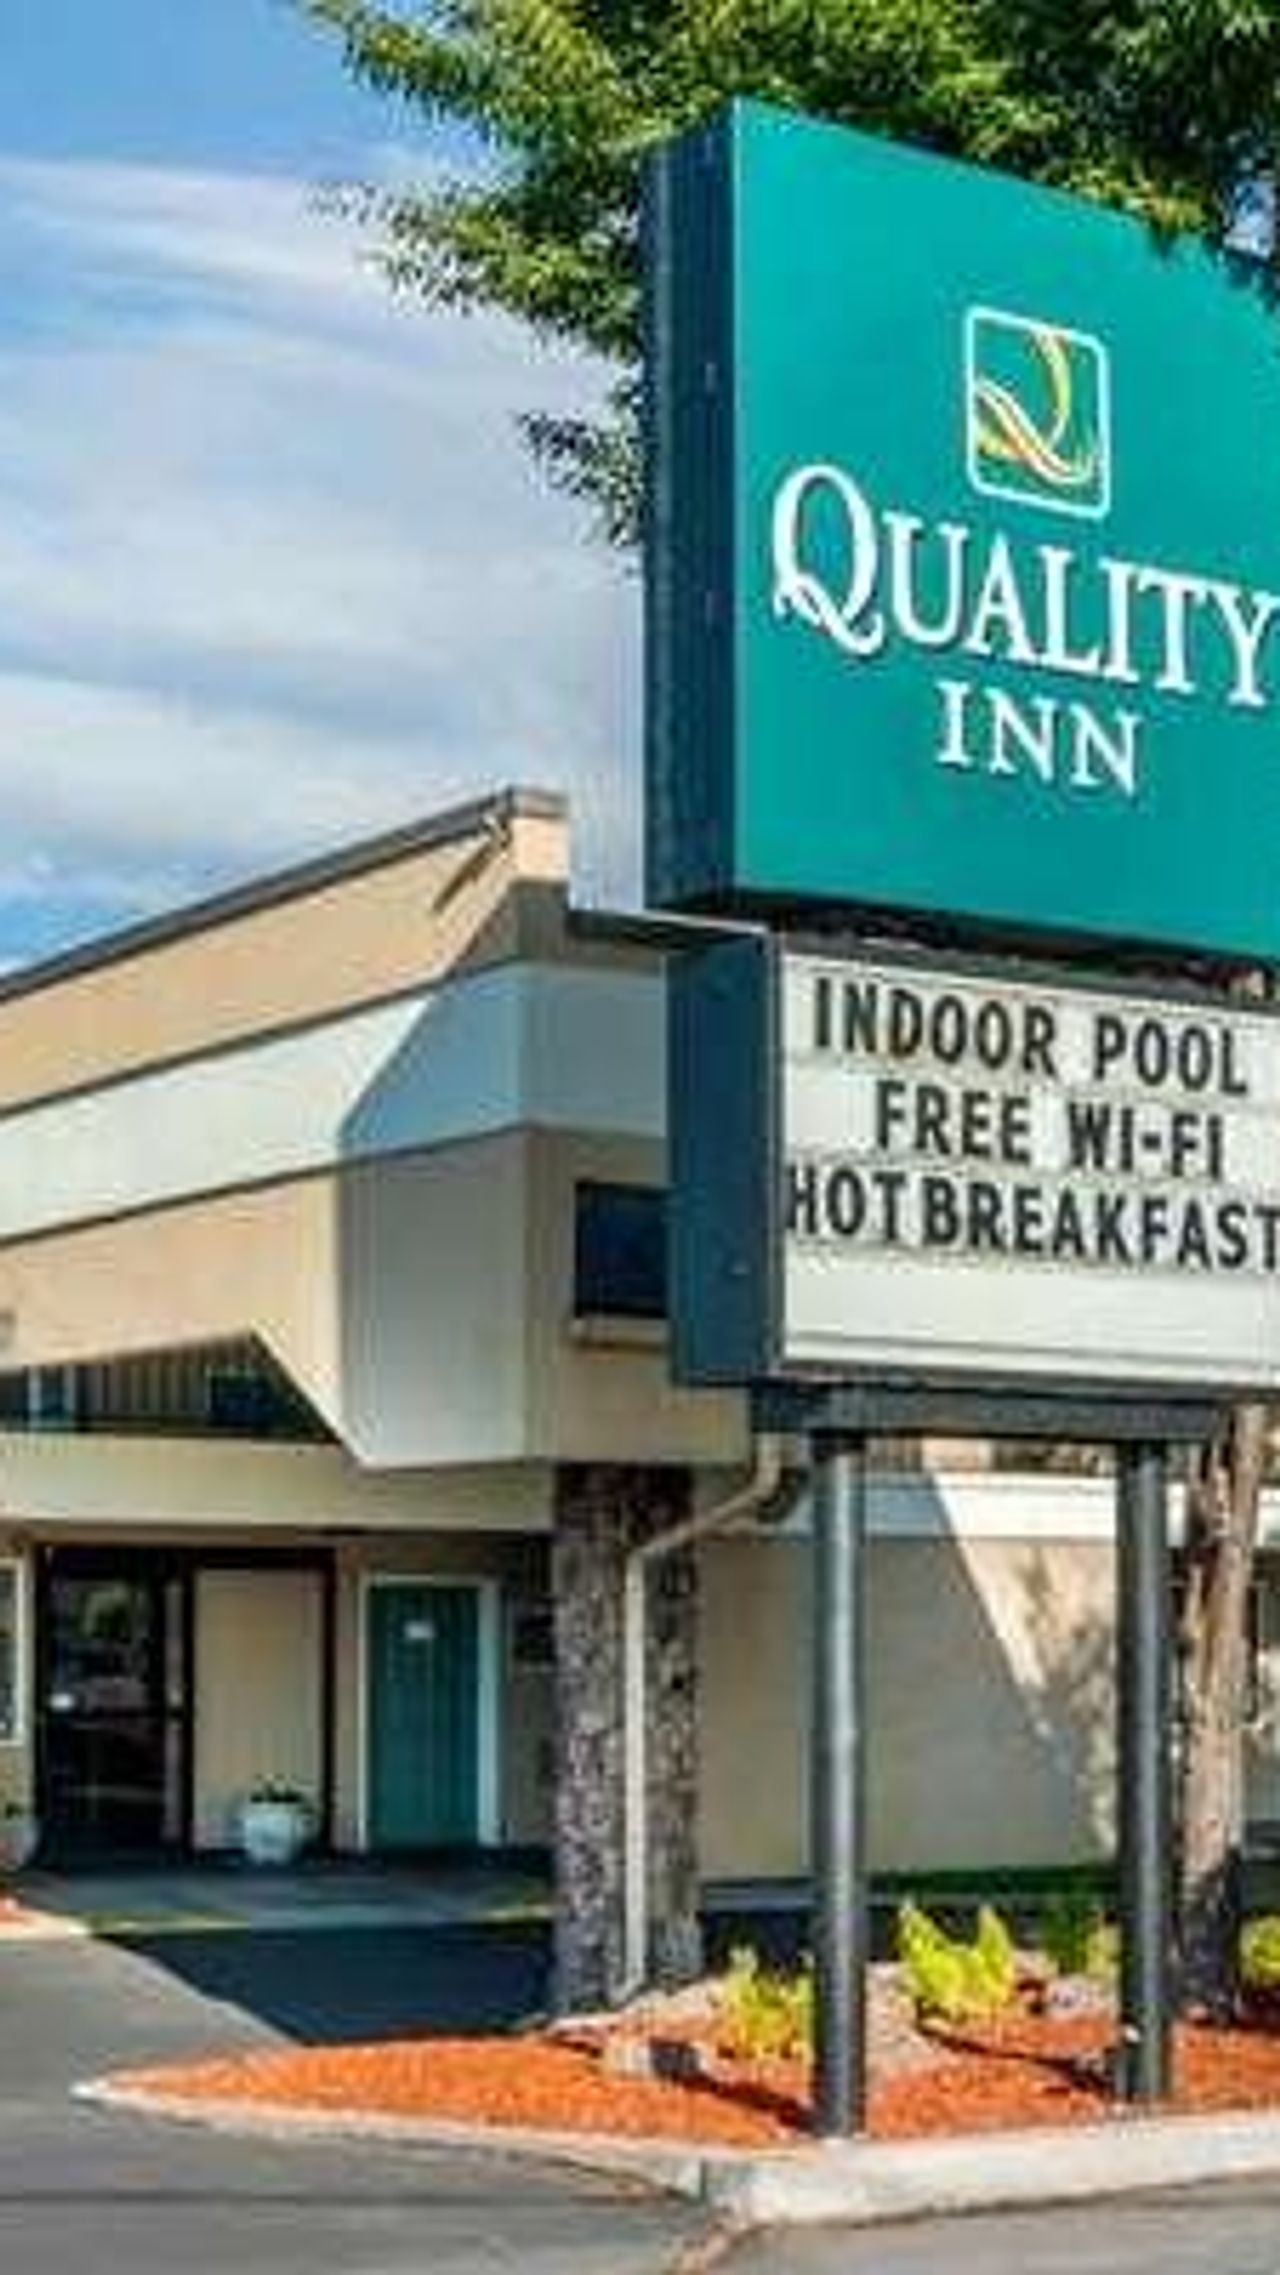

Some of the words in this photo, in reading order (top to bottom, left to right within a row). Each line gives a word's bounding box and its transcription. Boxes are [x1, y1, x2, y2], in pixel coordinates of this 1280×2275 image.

[772, 465, 1280, 707] QUALITY
[936, 680, 1142, 796] INN
[813, 977, 1057, 1078] INDOOR
[1093, 1014, 1247, 1096] POOL
[875, 1080, 1033, 1165] FREE
[1069, 1102, 1224, 1181] WI-FI
